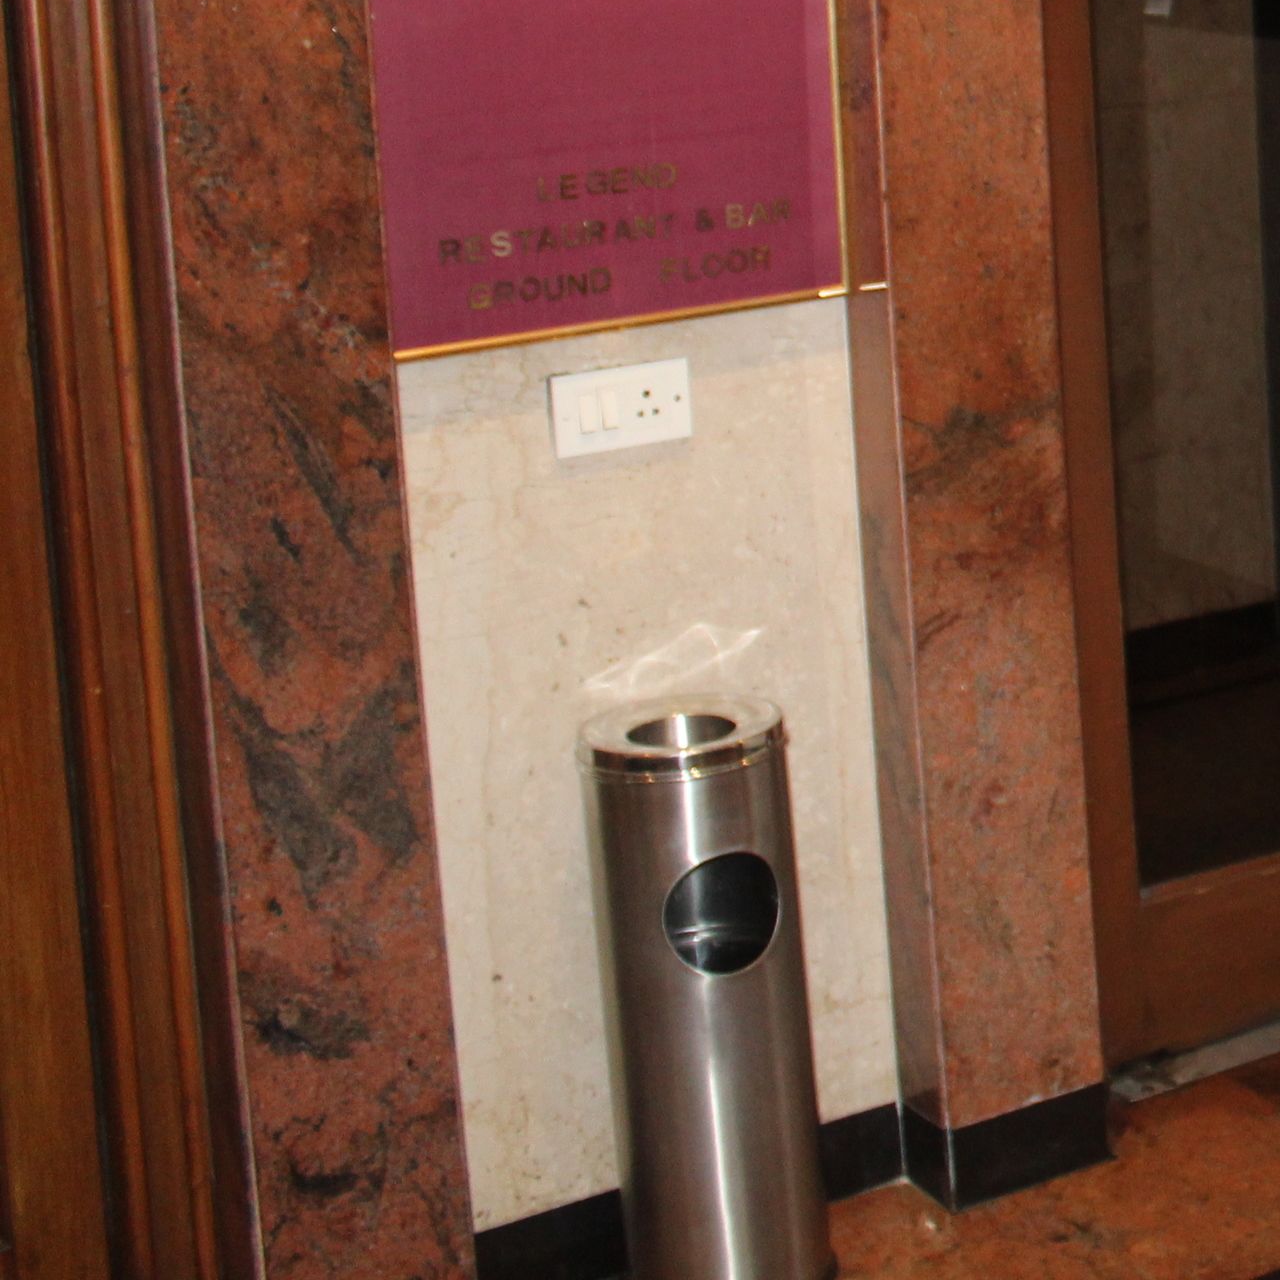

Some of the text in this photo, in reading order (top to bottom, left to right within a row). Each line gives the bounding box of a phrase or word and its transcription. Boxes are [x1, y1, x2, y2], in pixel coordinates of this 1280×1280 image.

[536, 162, 677, 202] LEGEND
[438, 212, 675, 267] RESTAURANT
[724, 197, 790, 230] BAR
[466, 244, 772, 311] GROUND FLOOR
